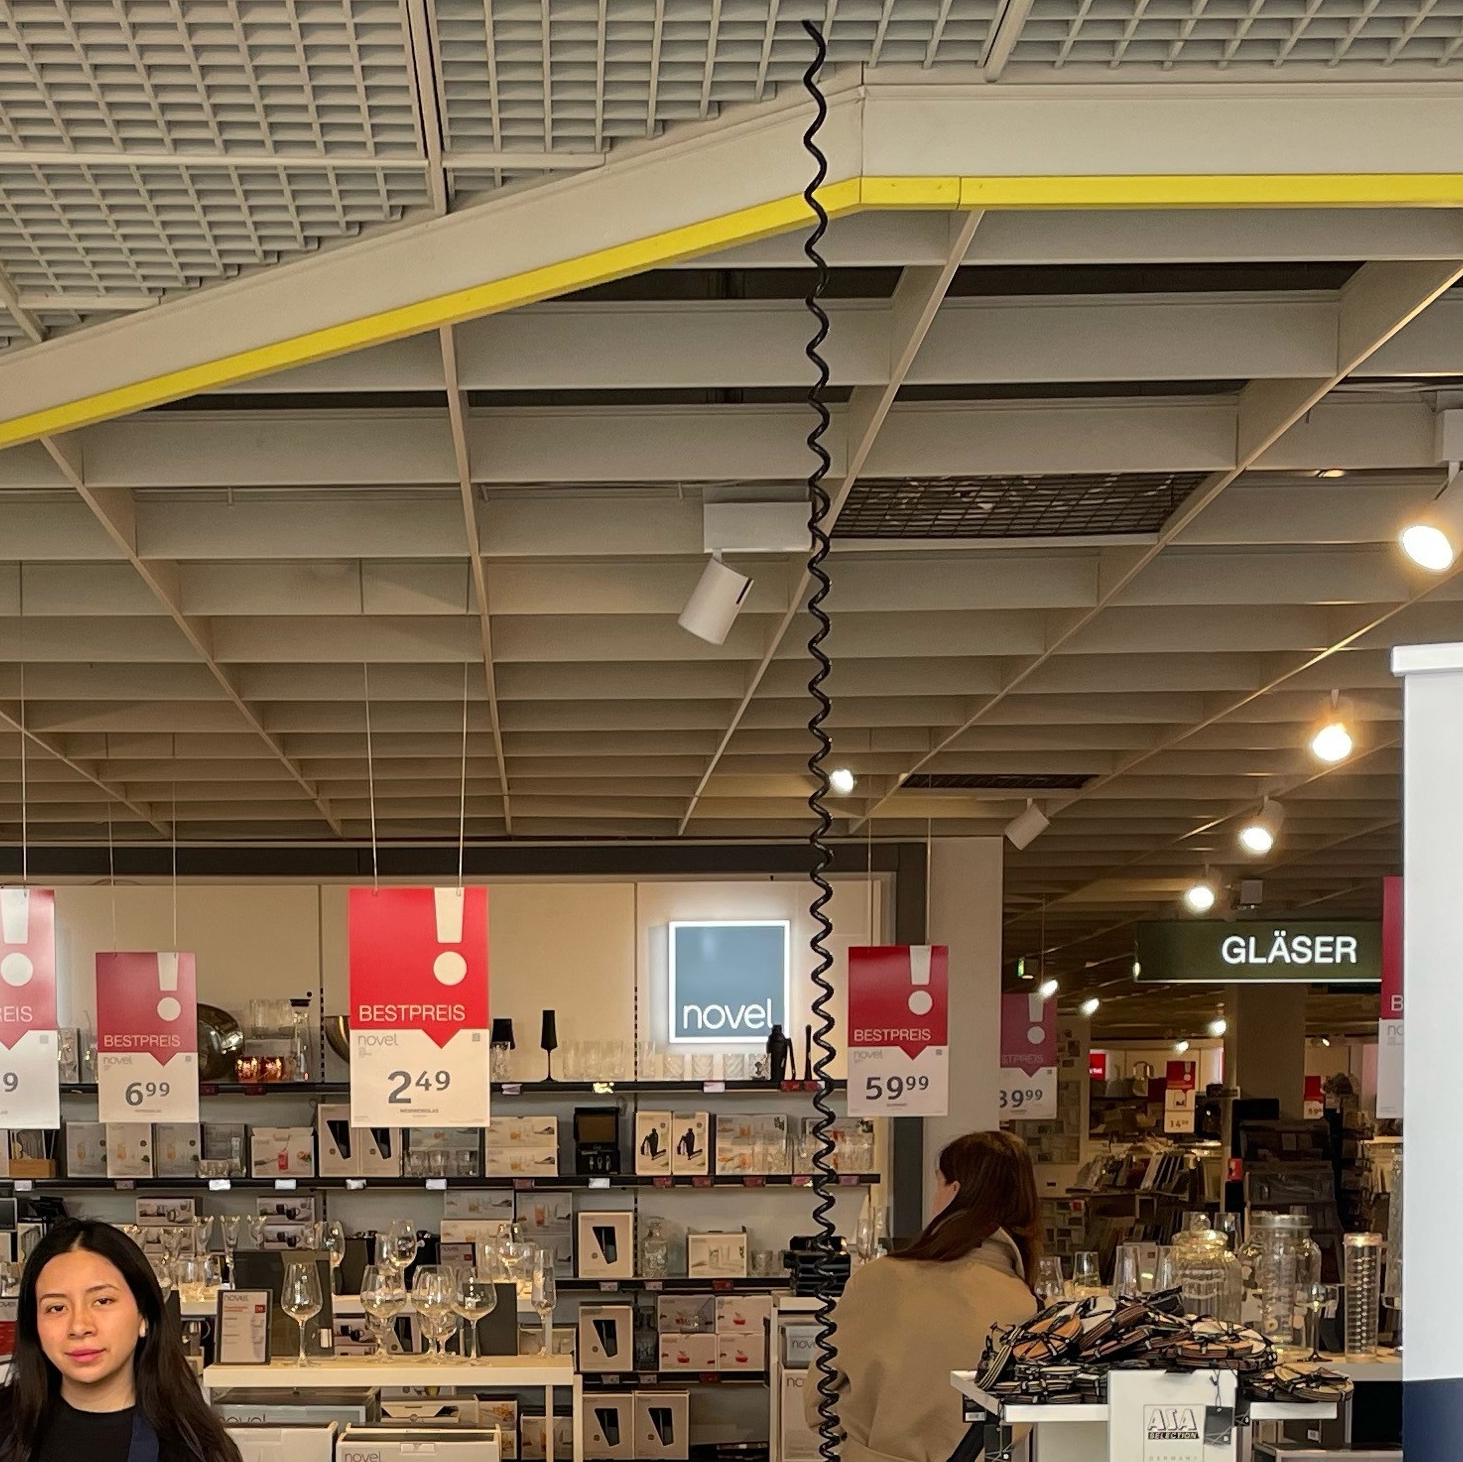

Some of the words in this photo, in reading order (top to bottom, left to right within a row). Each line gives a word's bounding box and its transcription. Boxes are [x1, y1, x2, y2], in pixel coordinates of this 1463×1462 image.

[1221, 929, 1358, 964] GLÄSER
[359, 1004, 466, 1022] BESTPREIS
[682, 997, 773, 1030] novel
[103, 1034, 181, 1048] BESTPREIS
[357, 1033, 399, 1047] novel
[853, 1028, 932, 1042] BESTPREIS
[103, 1055, 133, 1066] novel
[853, 1050, 883, 1060] novel
[791, 1339, 818, 1350] nov
[1147, 1408, 1198, 1431] ASA
